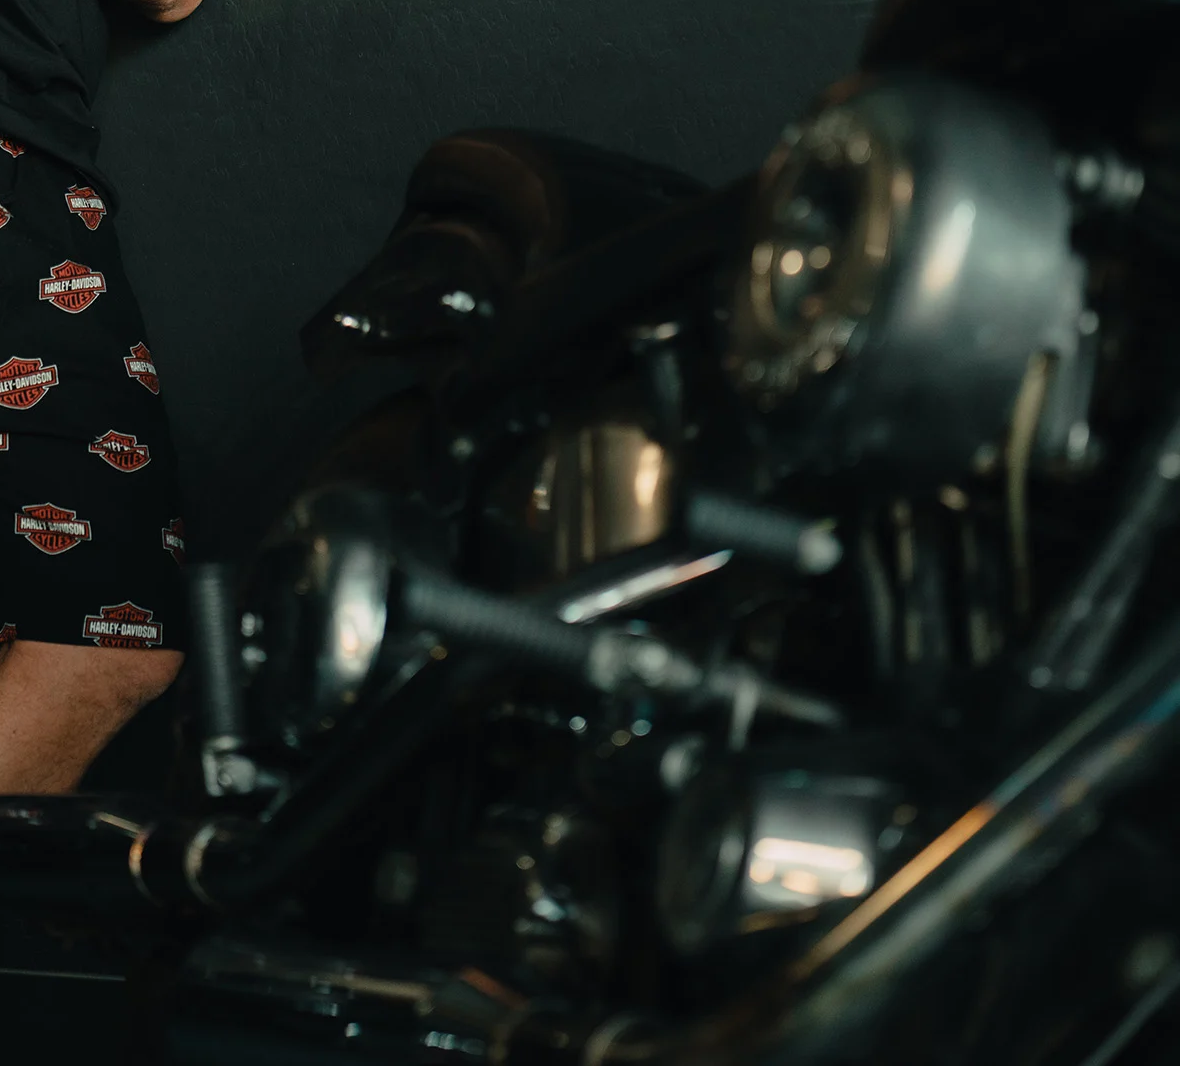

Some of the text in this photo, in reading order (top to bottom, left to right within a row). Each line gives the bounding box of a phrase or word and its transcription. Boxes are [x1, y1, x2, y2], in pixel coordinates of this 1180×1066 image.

[44, 275, 103, 295] HARLEY-DAVIDSON
[58, 291, 91, 309] CYCLES
[0, 362, 37, 379] MOTOR
[2, 387, 39, 405] CYCLES
[33, 534, 71, 550] CYCLES
[108, 608, 146, 621] MOTOR
[89, 620, 158, 639] HARLEY-DAVIDSON
